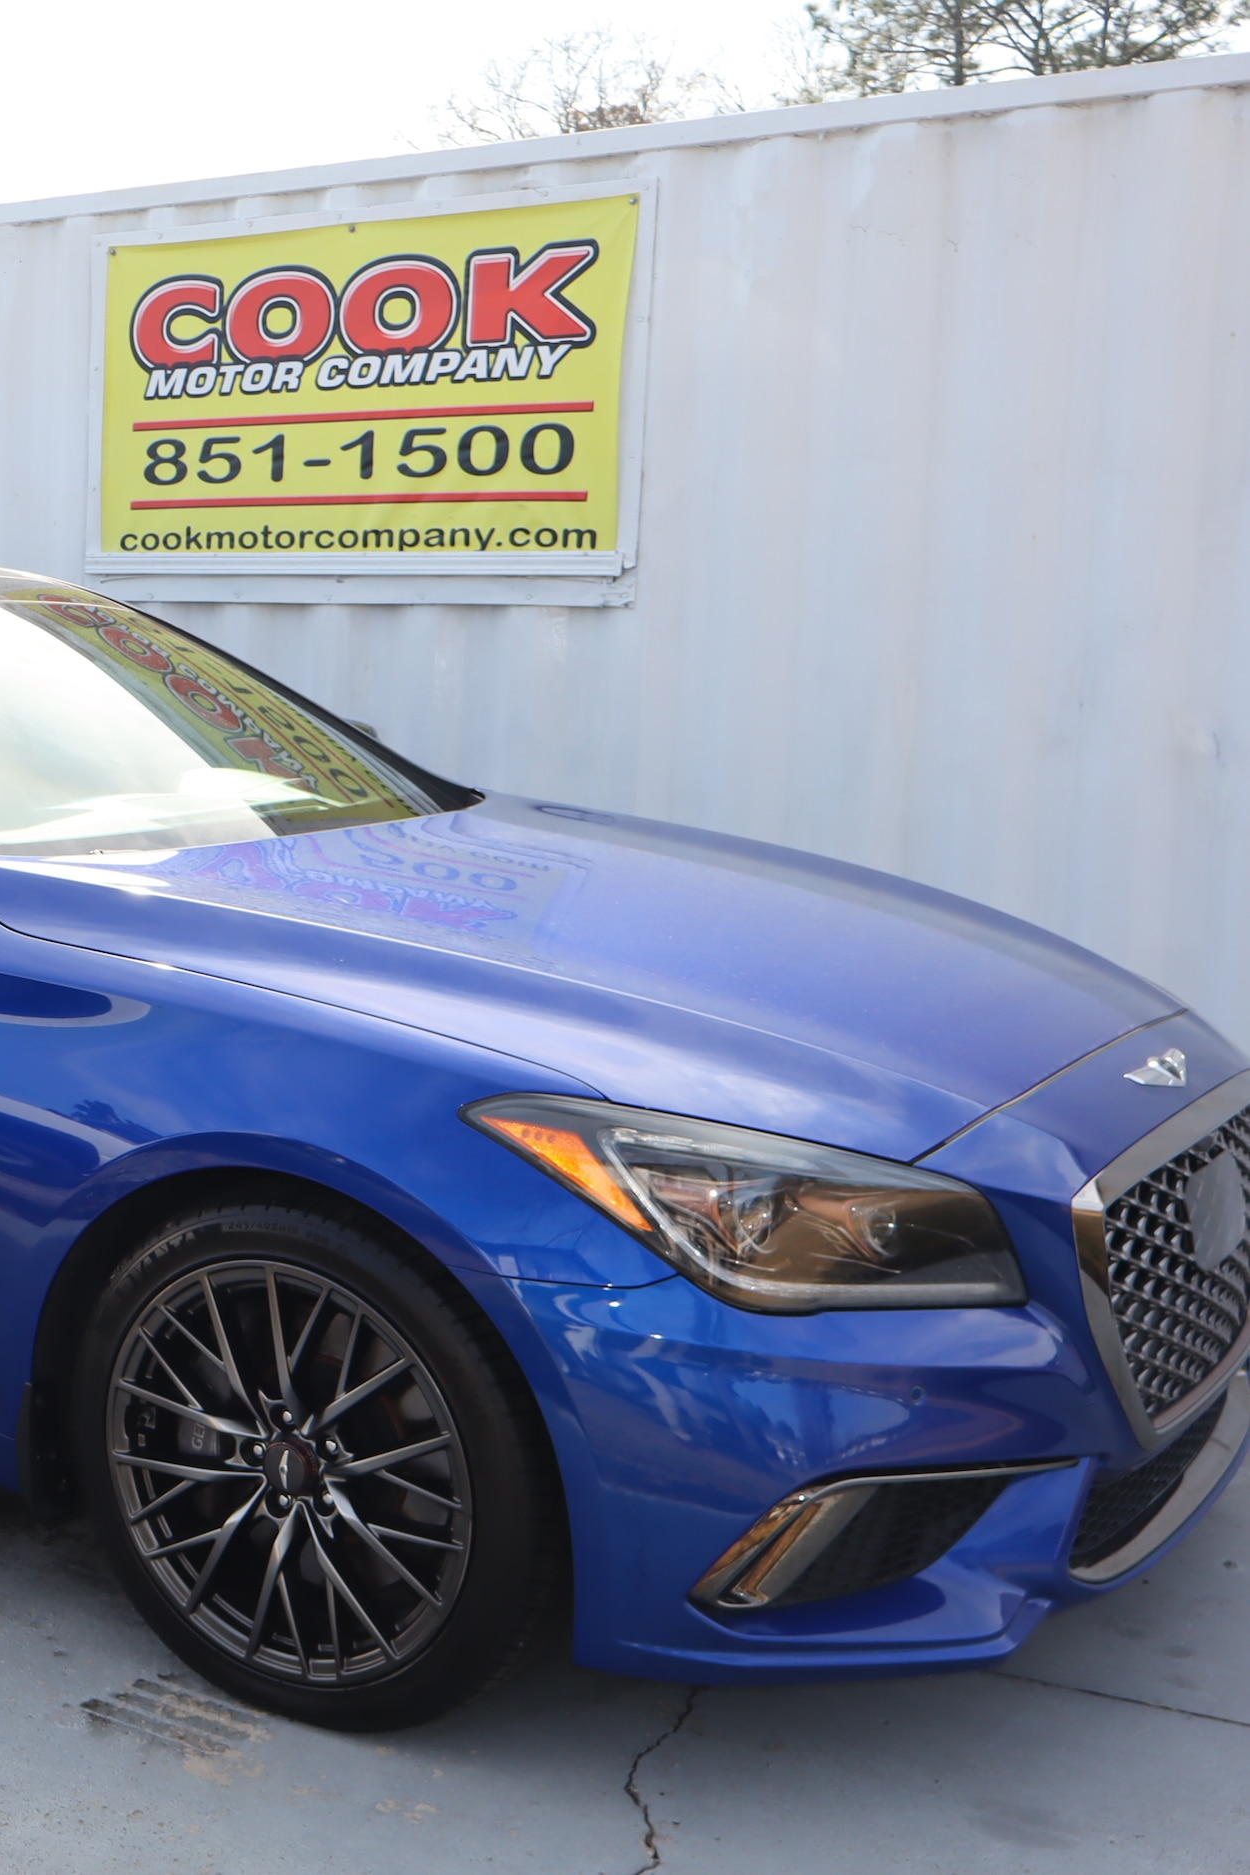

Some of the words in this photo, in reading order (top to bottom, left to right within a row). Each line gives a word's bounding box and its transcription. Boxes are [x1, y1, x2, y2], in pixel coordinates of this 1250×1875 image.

[130, 239, 599, 371] COOK
[144, 359, 310, 400] MOTOR
[315, 344, 573, 390] COMPANY
[143, 422, 575, 485] 851-1500
[119, 524, 598, 552] cookmotorcompany.com
